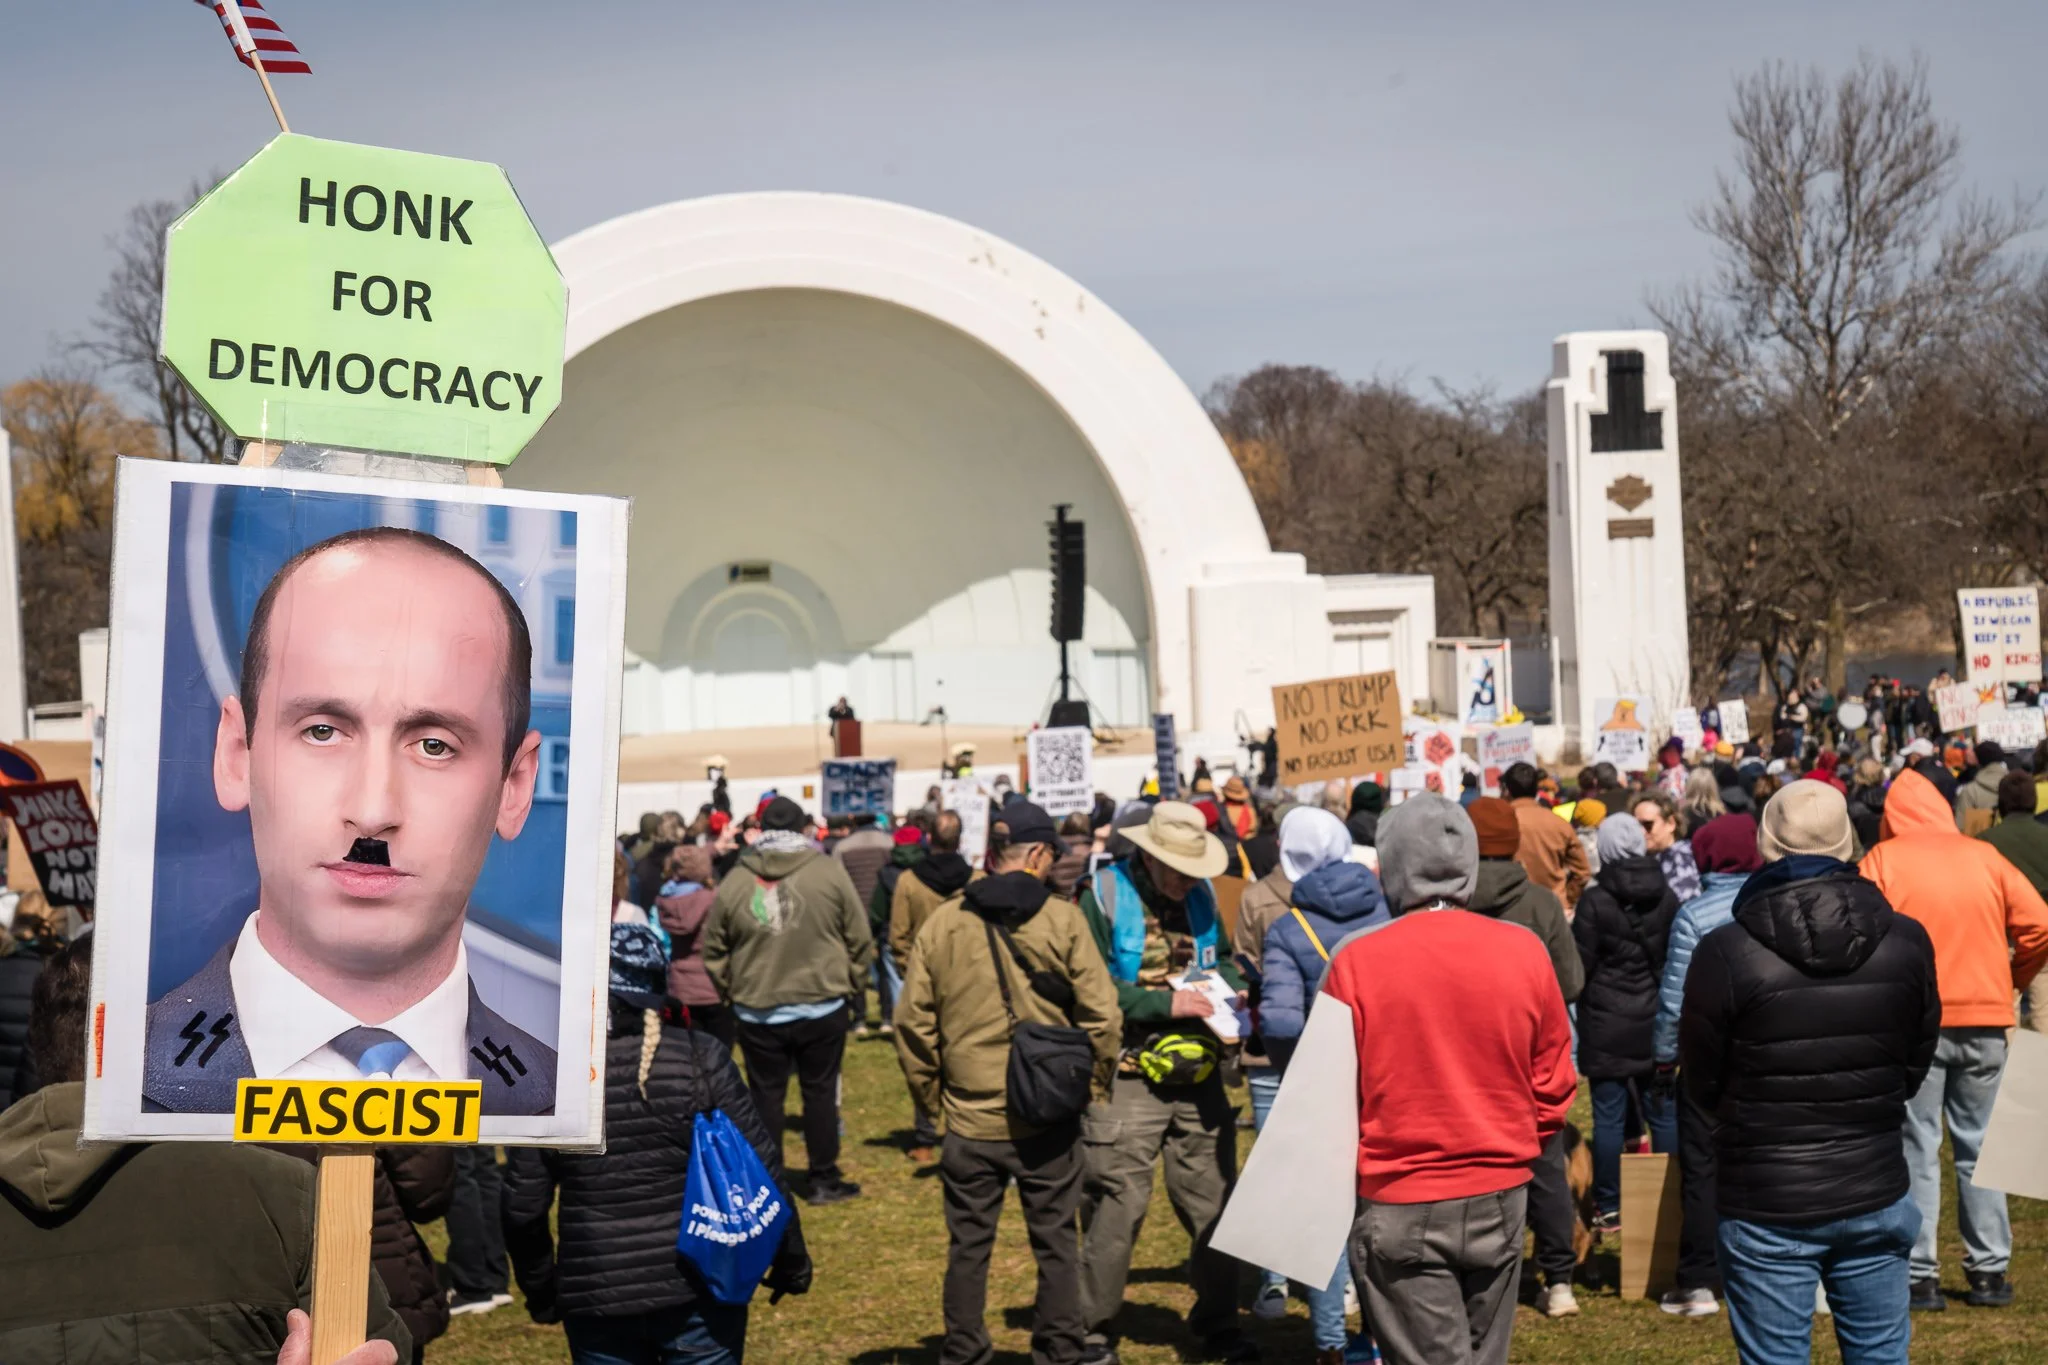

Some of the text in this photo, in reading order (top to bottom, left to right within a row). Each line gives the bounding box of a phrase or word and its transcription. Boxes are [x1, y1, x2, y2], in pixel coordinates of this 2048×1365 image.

[299, 177, 473, 245] HONK
[333, 270, 433, 322] FOR
[208, 338, 543, 414] DEMOCRACY
[1974, 654, 1991, 670] NO
[1282, 675, 1391, 721] NO TRUMP
[1300, 709, 1389, 746] NO KKK
[1285, 757, 1302, 774] NO
[1367, 744, 1396, 763] USA
[10, 788, 88, 826] MAKE
[831, 789, 885, 812] ICE
[49, 868, 96, 902] WA
[242, 1085, 480, 1137] FASCIST
[687, 1220, 696, 1234] I
